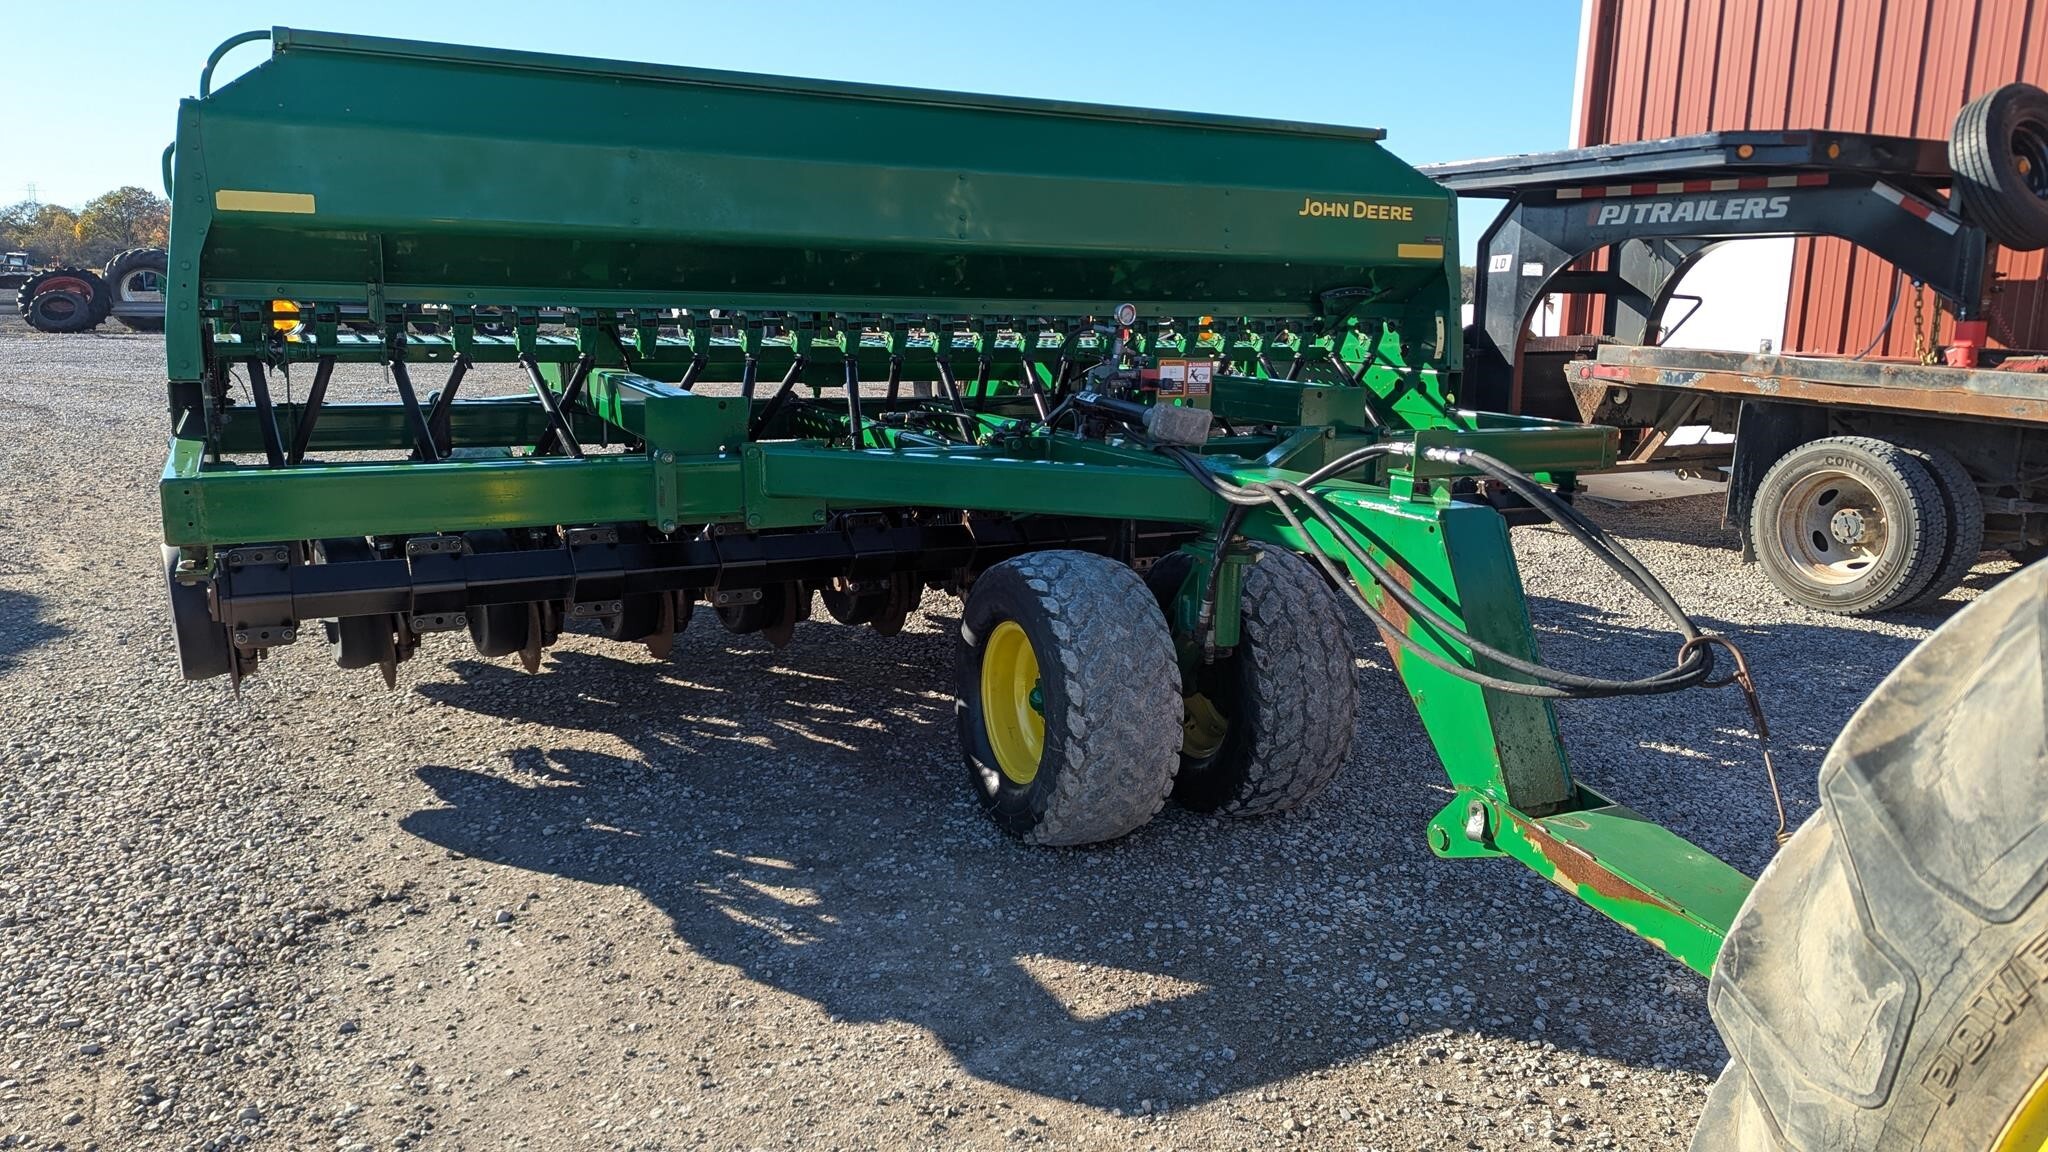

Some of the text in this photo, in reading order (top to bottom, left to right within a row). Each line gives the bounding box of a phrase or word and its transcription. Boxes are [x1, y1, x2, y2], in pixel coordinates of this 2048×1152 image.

[1299, 198, 1413, 221] JOHN DEERE
[1598, 196, 1791, 225] PJ TRAILERS
